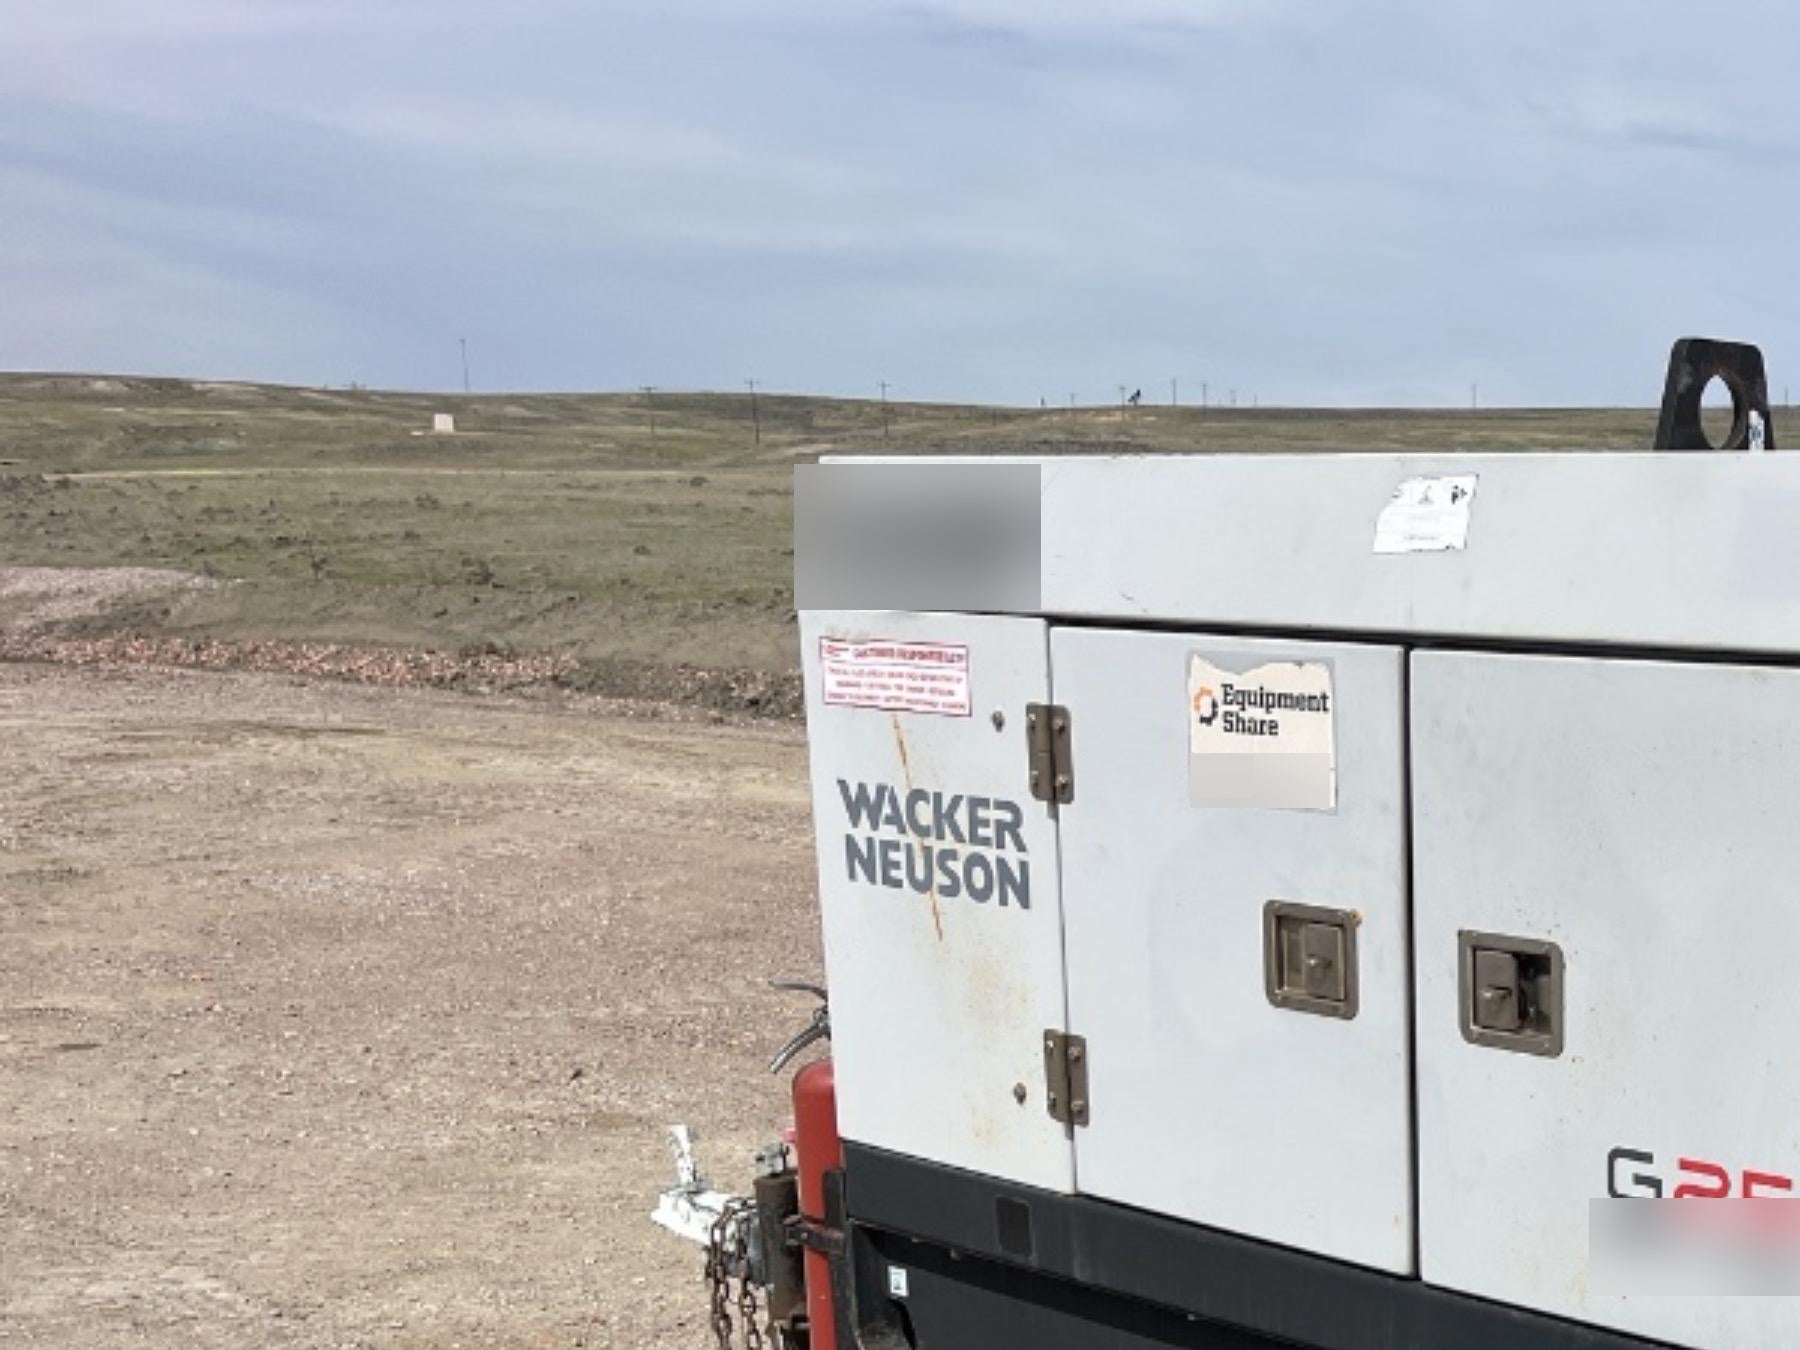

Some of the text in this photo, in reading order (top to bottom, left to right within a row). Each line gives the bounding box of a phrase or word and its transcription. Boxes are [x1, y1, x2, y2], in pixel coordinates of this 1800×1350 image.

[1221, 683, 1329, 714] Equipment
[1223, 711, 1279, 736] Share
[836, 778, 1028, 853] WACKER
[845, 833, 1030, 910] NEUSON
